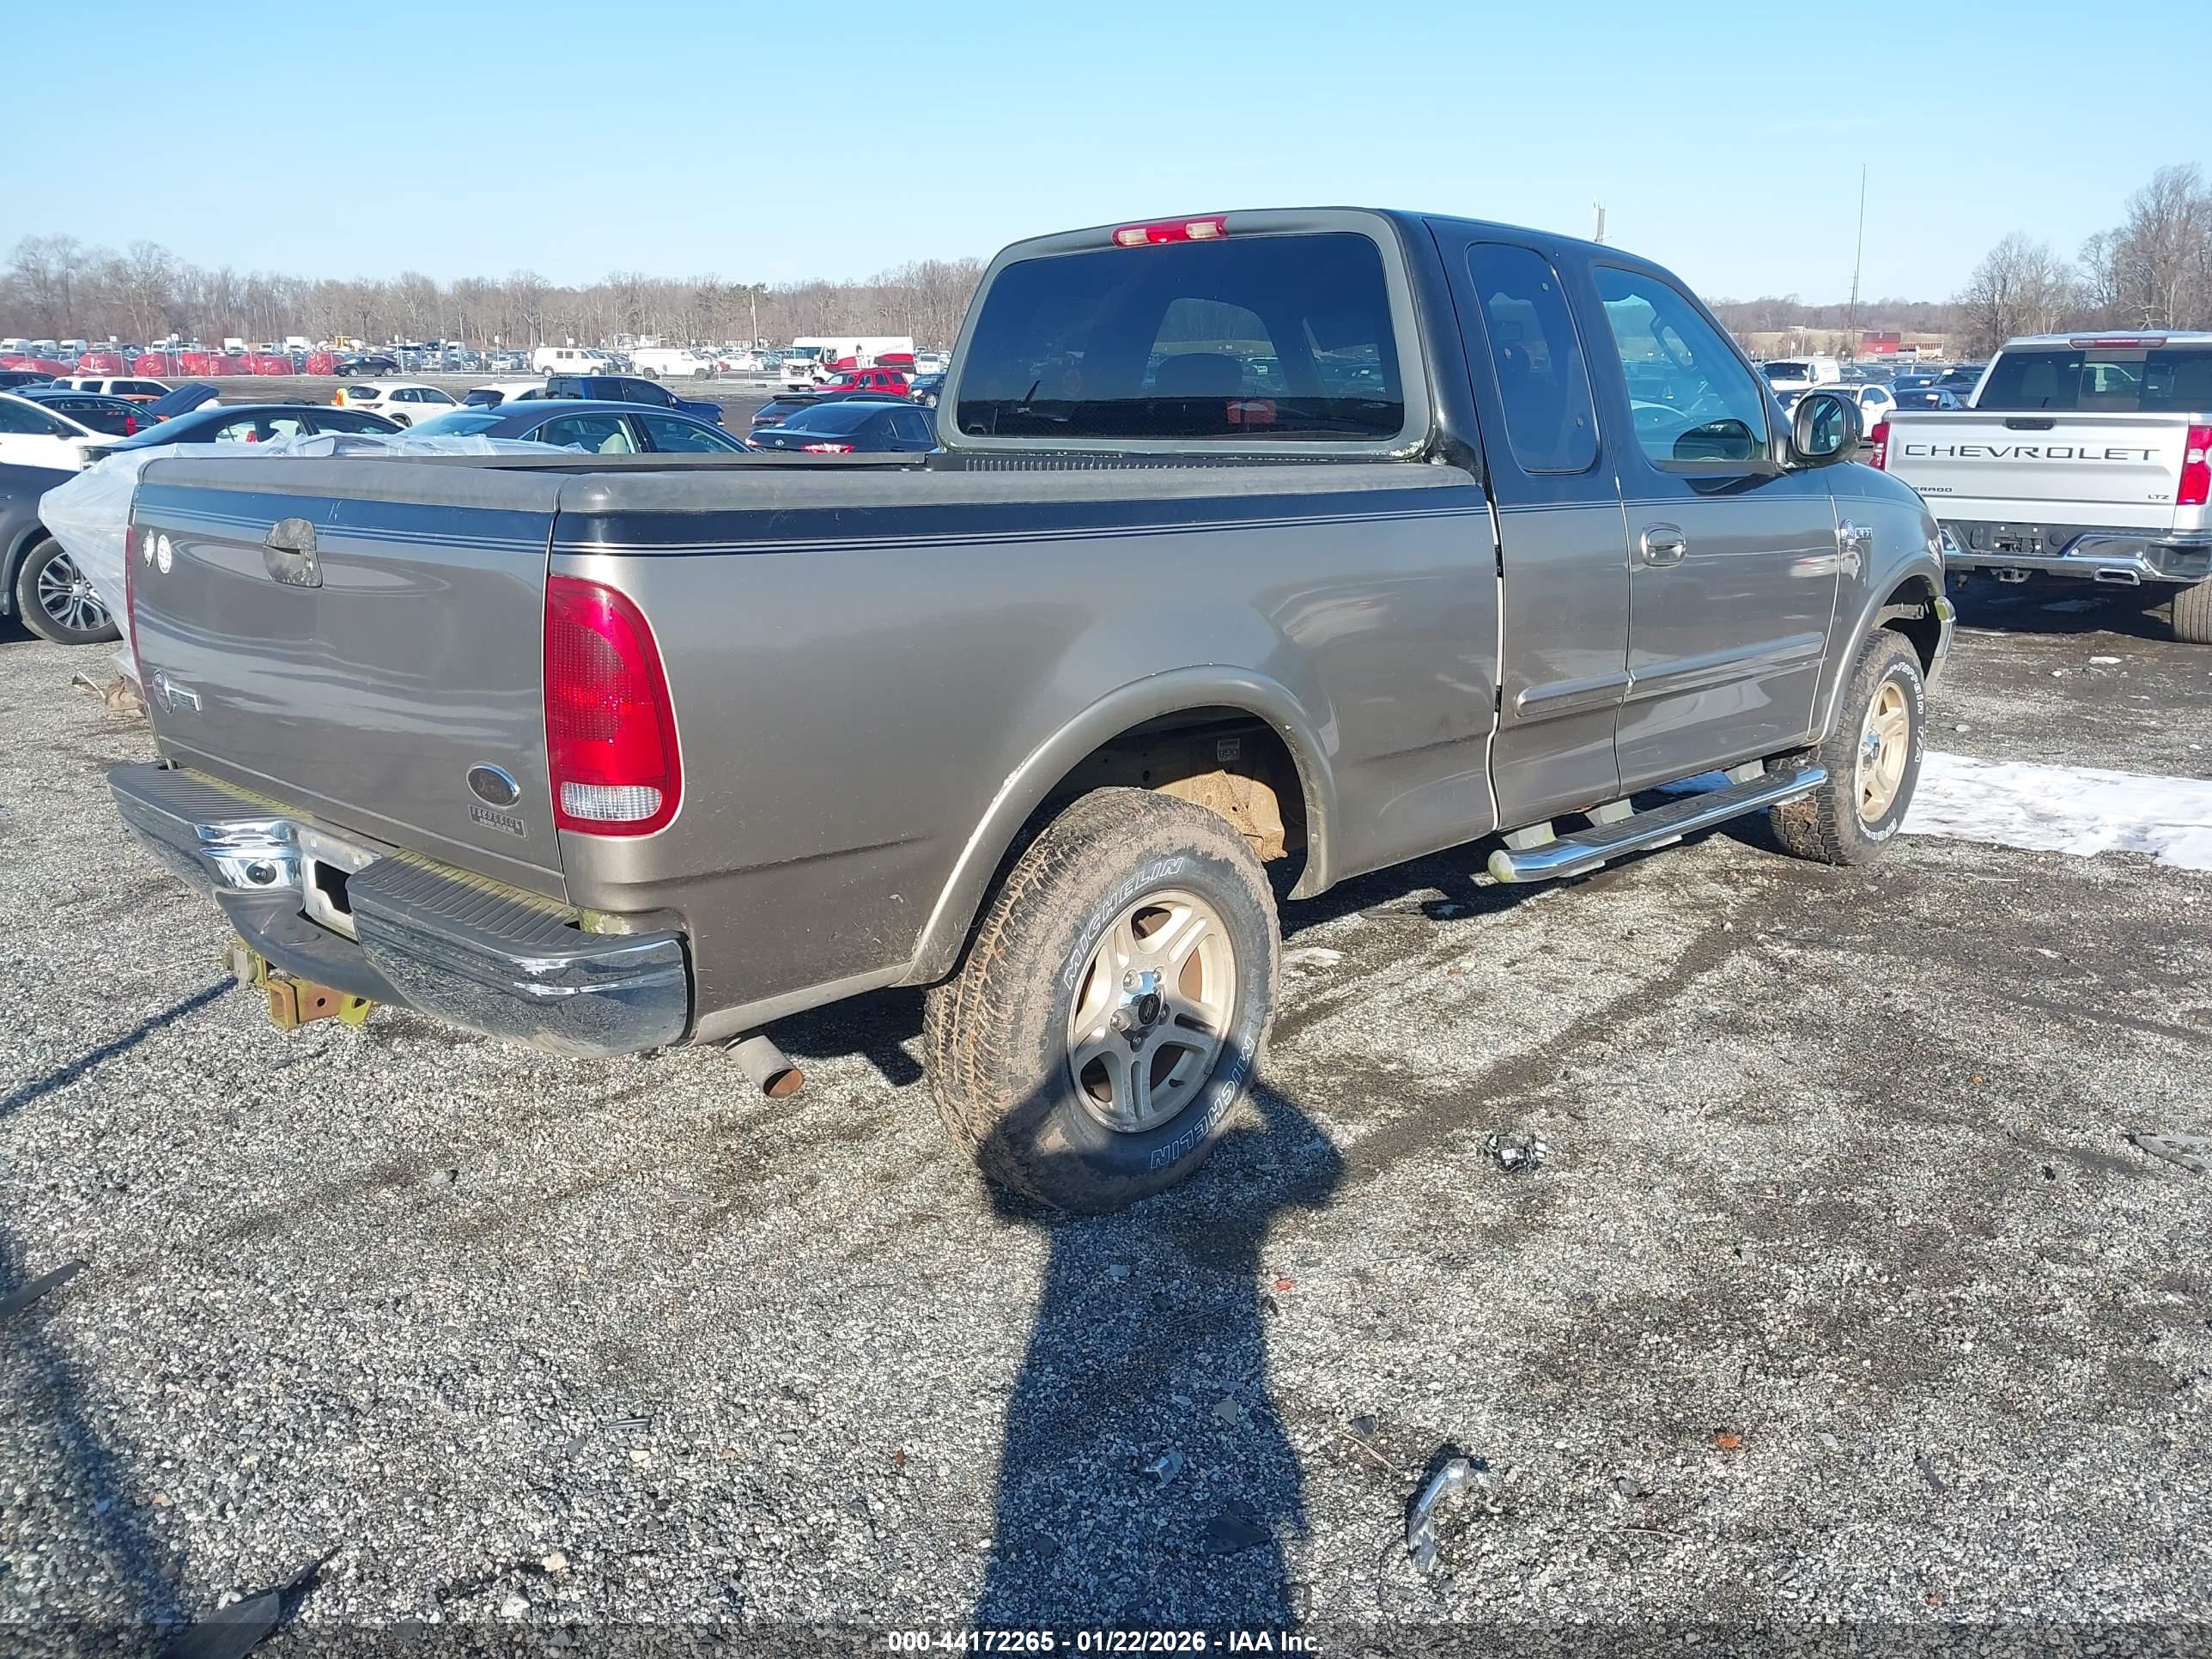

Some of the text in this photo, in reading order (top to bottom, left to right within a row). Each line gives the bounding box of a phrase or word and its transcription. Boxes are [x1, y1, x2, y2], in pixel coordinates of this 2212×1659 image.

[1905, 444, 2161, 461] CHEVROLET
[1063, 856, 1184, 991] MICHELIN
[1150, 1035, 1256, 1170] MICHELIN
